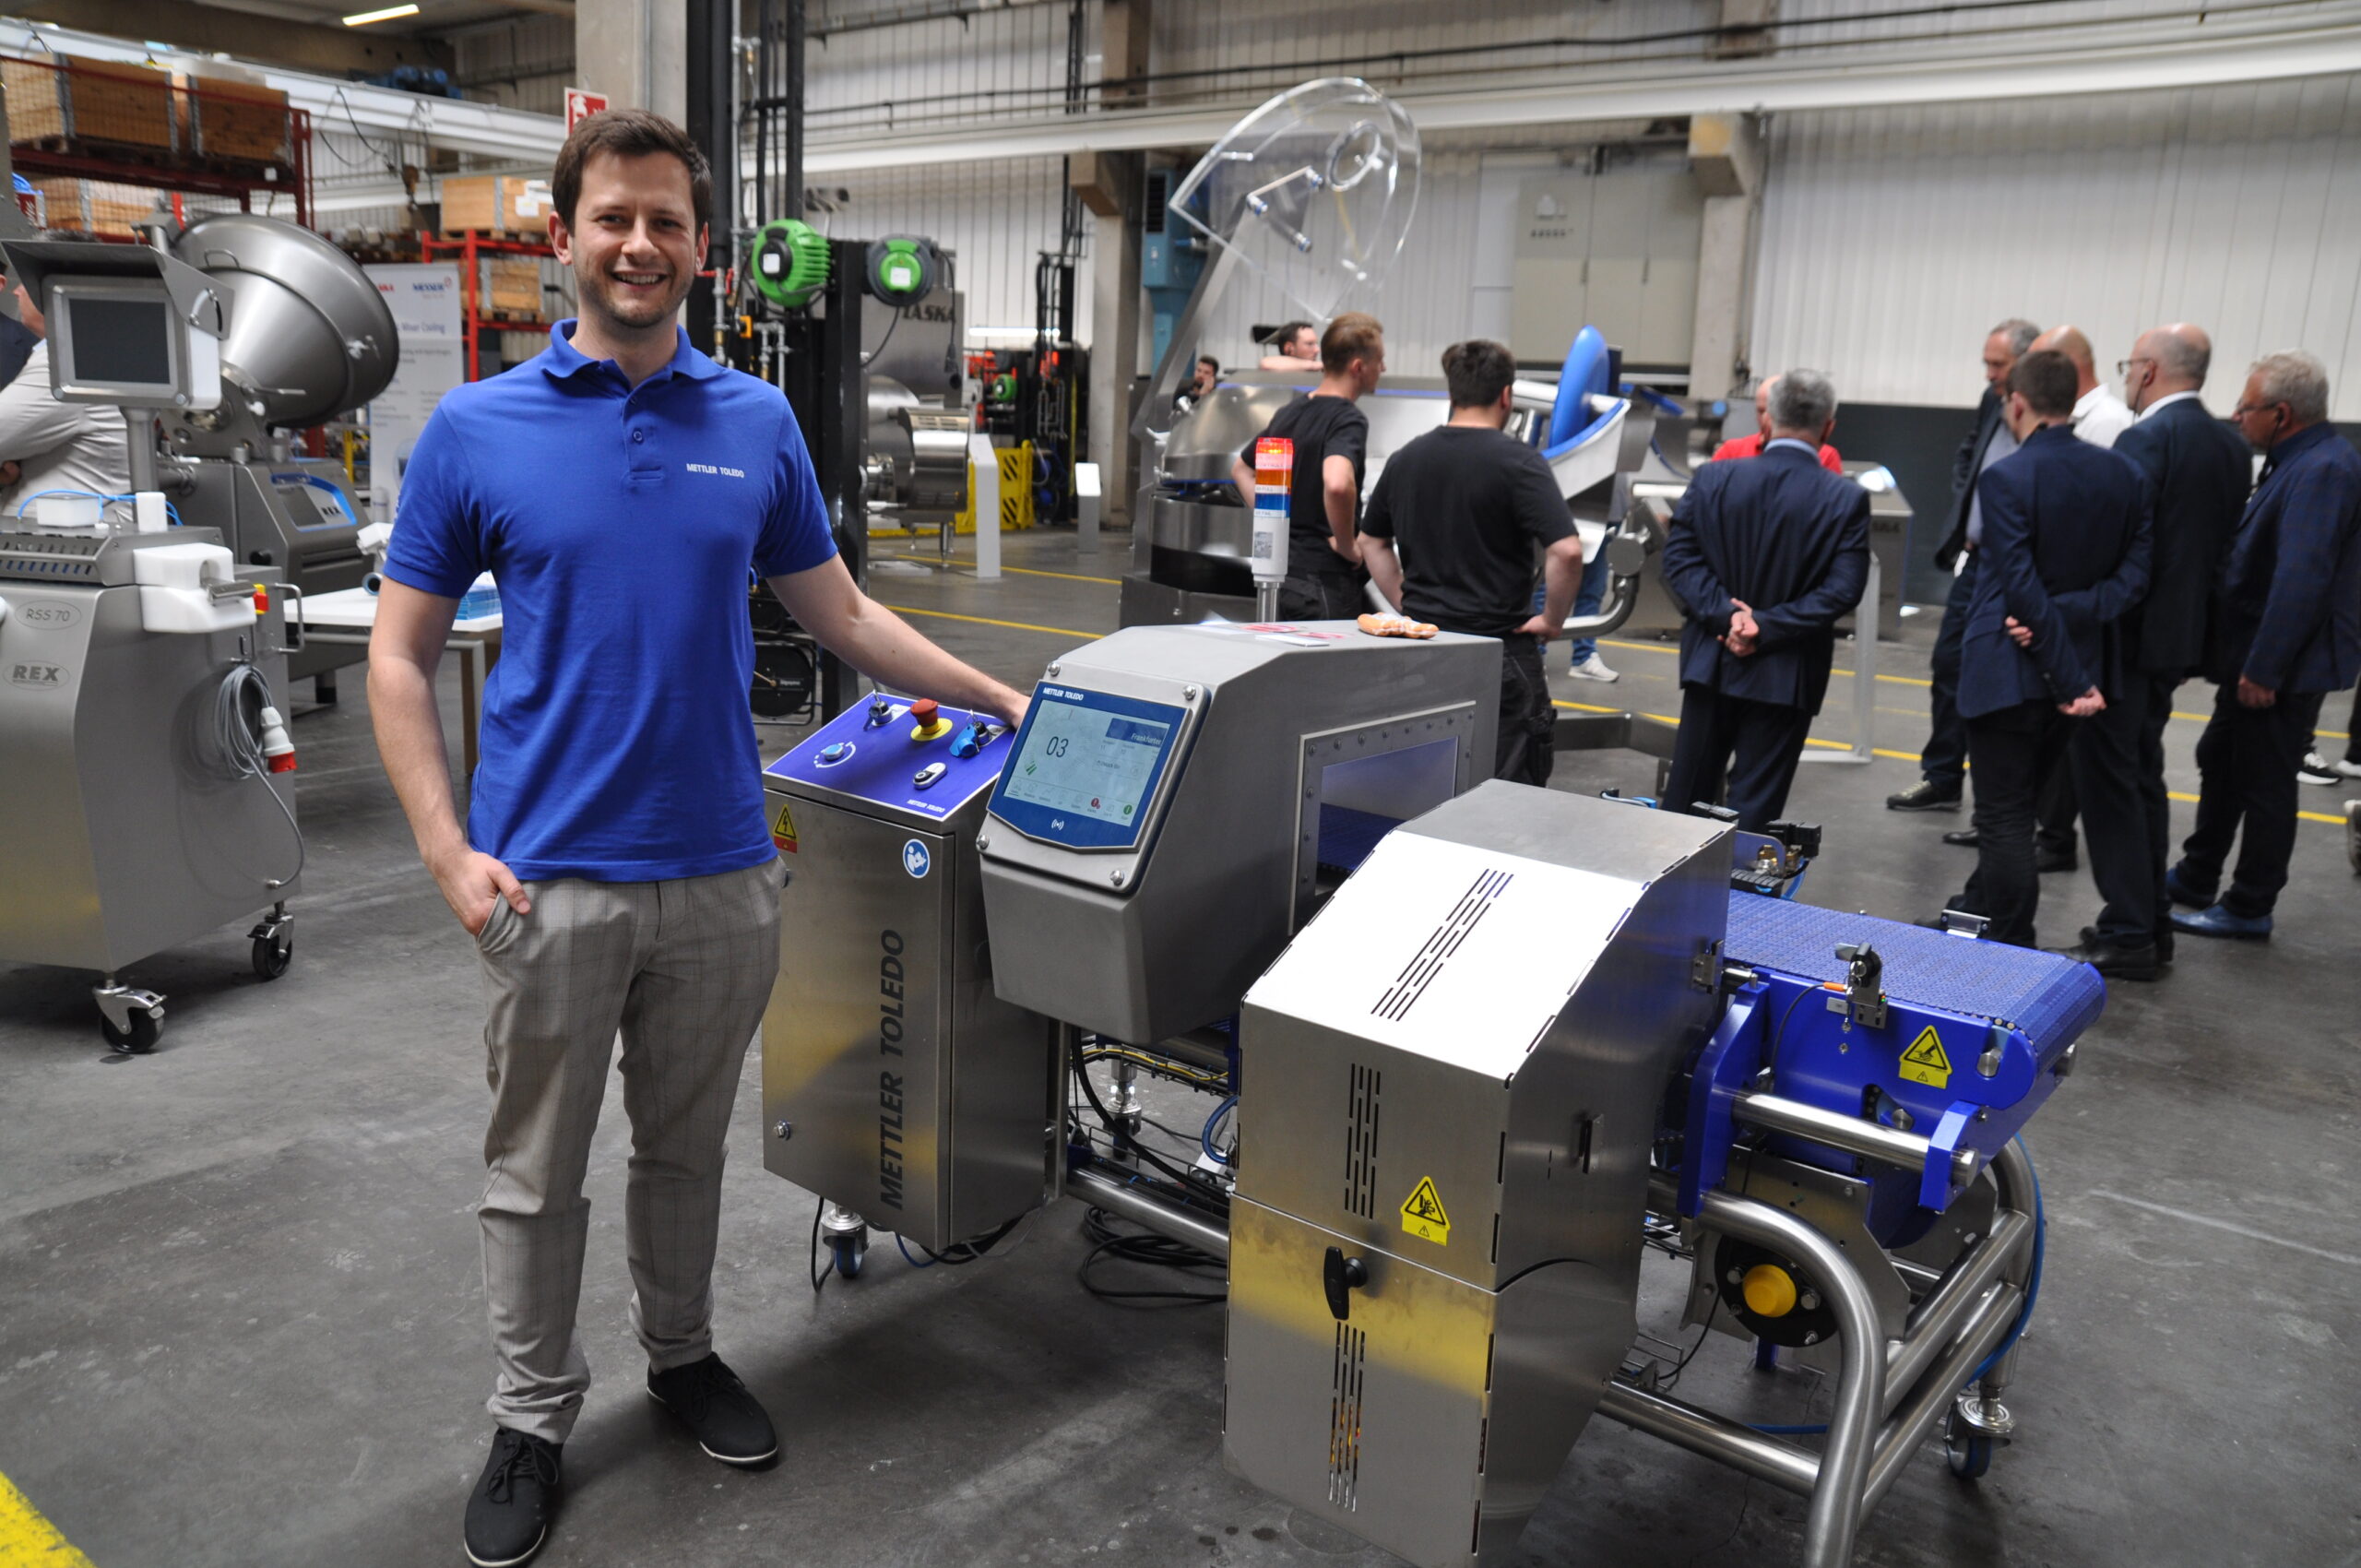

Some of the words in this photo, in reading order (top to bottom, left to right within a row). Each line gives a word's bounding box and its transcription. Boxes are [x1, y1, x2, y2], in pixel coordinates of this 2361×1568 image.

[686, 463, 718, 474] METTLER
[719, 467, 744, 478] TOLEDO
[26, 609, 51, 621] RSS
[55, 611, 70, 622] 70
[13, 664, 60, 682] REX
[1042, 687, 1064, 698] METTLER
[1064, 691, 1085, 701] TOLEDO
[1047, 736, 1069, 758] 03
[880, 930, 905, 1058] TOLEDO
[880, 1071, 904, 1211] METTLER
